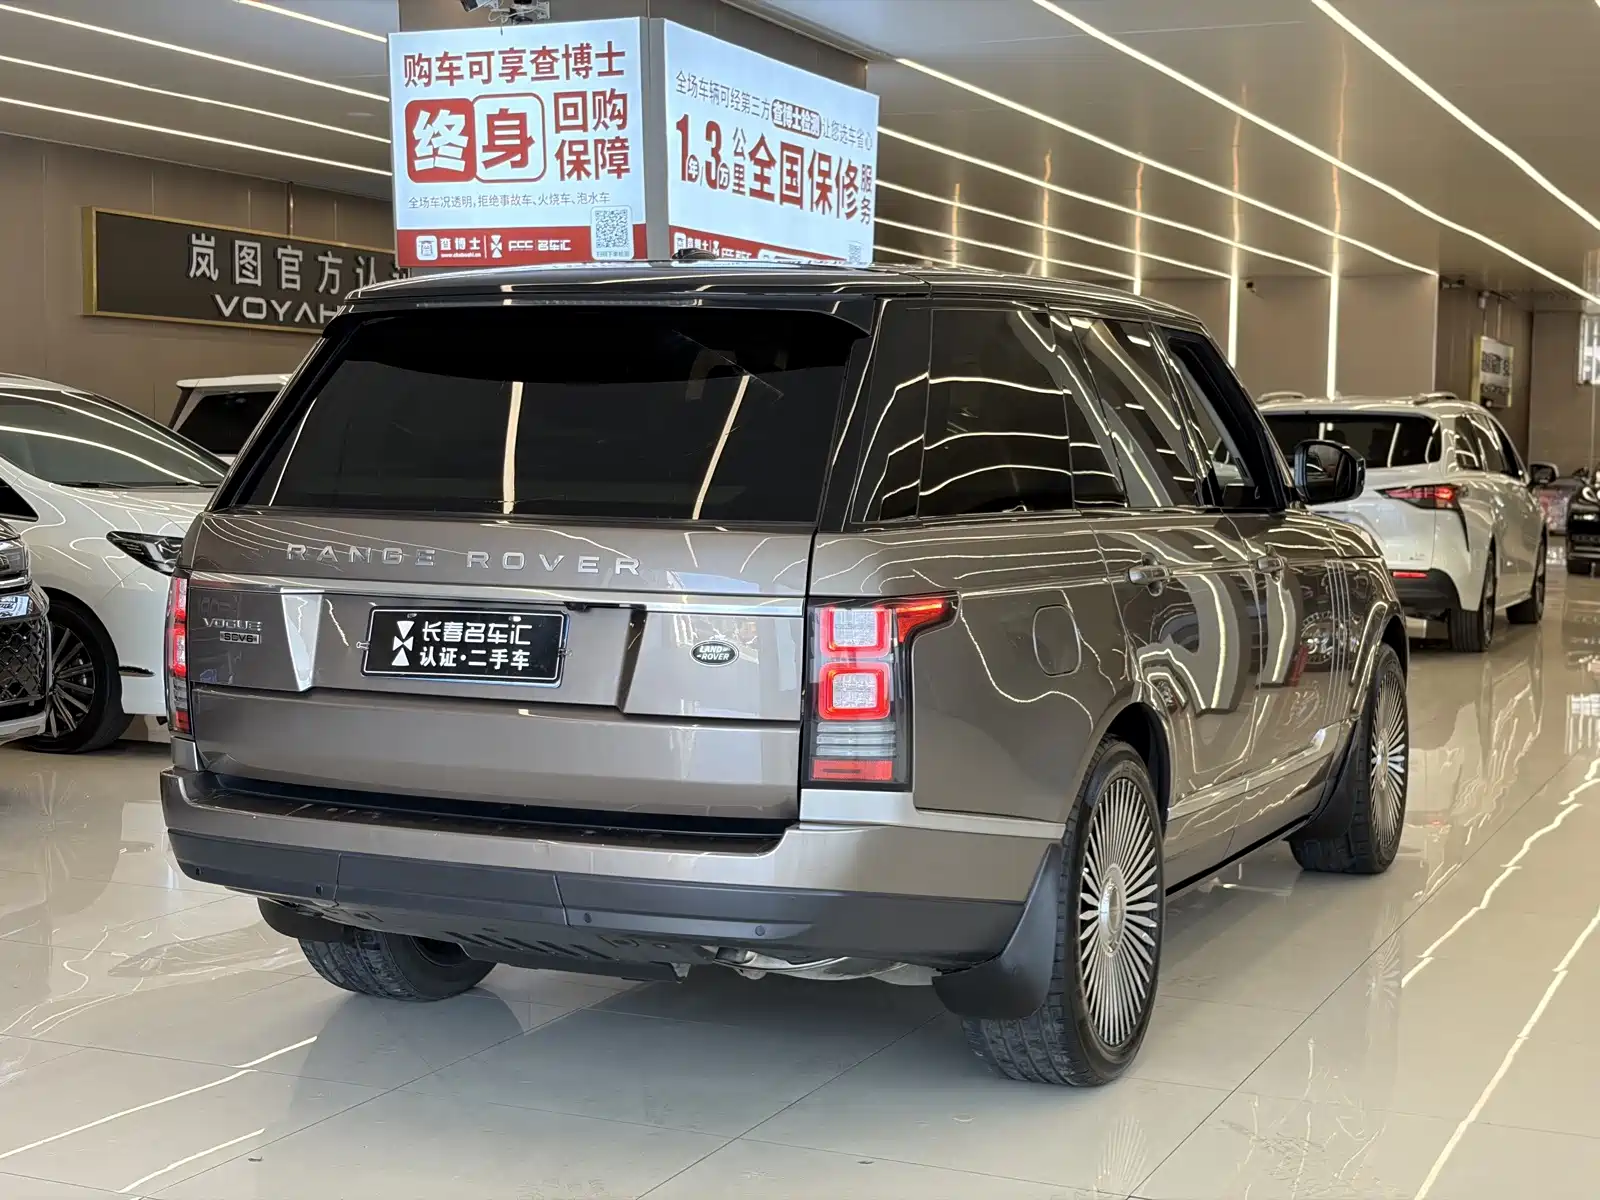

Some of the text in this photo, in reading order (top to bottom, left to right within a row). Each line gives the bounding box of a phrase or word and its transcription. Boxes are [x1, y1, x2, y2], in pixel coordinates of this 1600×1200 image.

[403, 40, 626, 88] 购车可享查博士
[553, 87, 629, 134] 回购
[412, 107, 536, 173] 终身
[554, 135, 632, 182] 保障
[439, 237, 482, 251] 查博士
[213, 293, 342, 324] VOYAH
[286, 543, 641, 576] RANGE ROVER
[202, 617, 262, 631] VOGUE
[422, 620, 533, 645] 长春名车汇
[419, 645, 531, 671] 认证·二手车
[699, 645, 723, 653] LAND
[701, 653, 730, 661] ROVER
